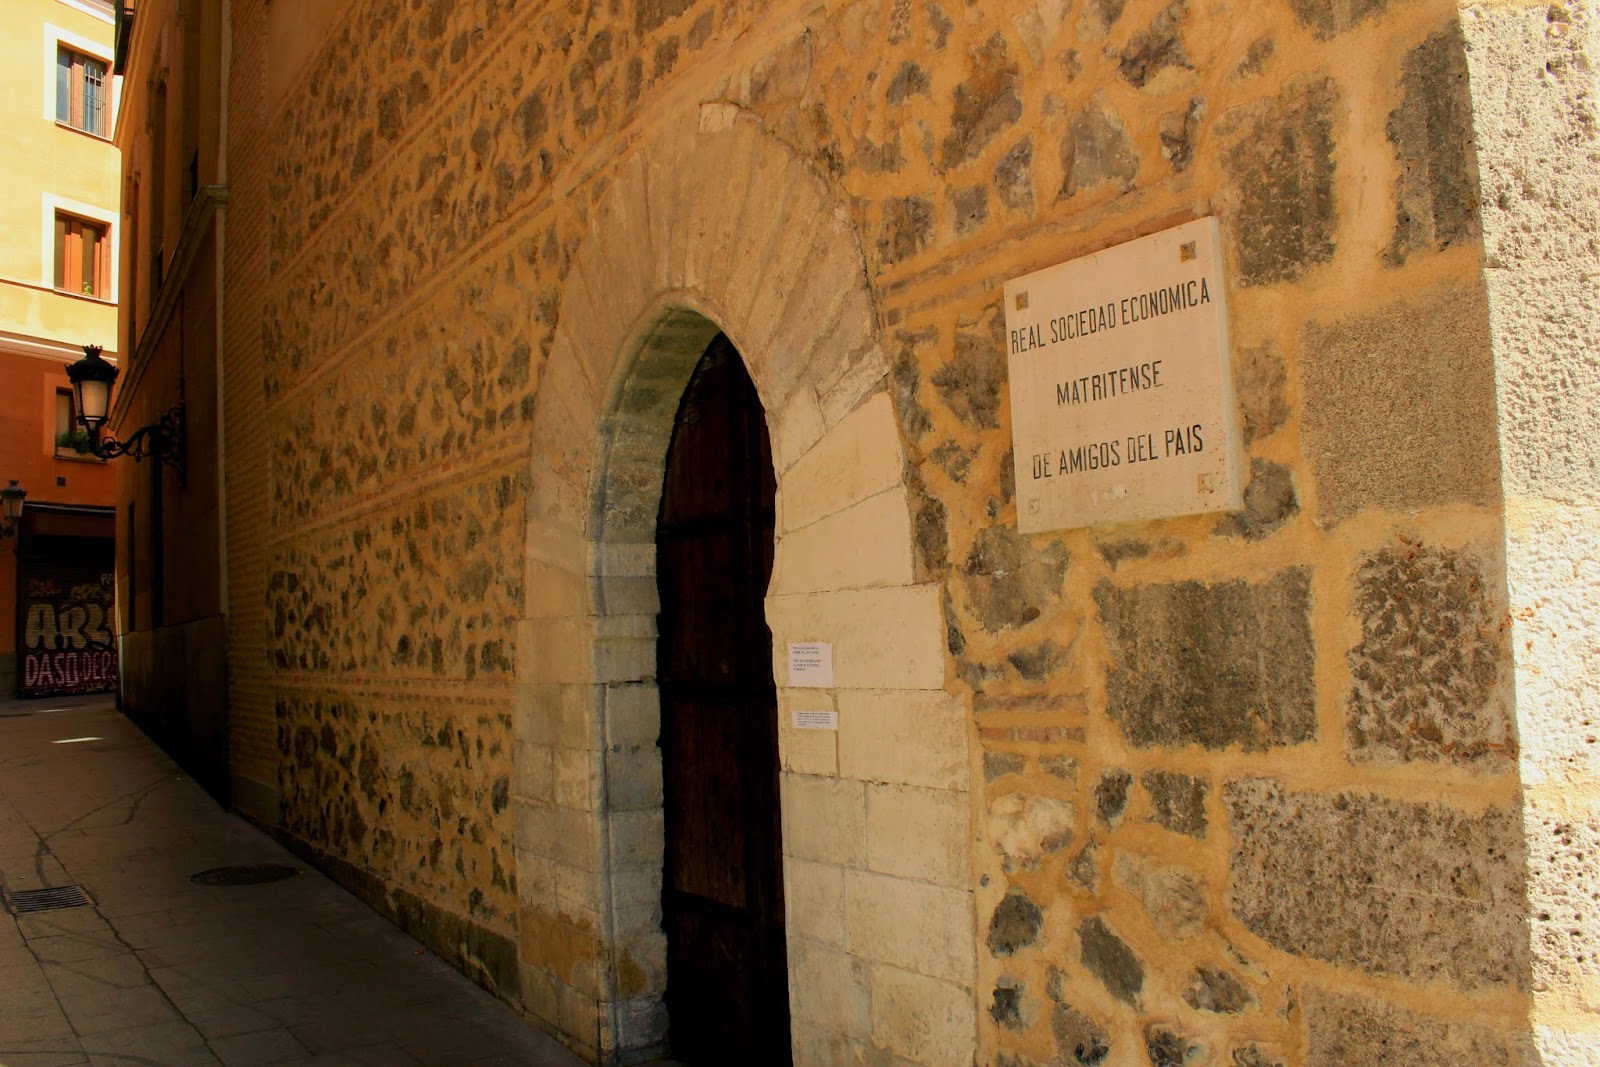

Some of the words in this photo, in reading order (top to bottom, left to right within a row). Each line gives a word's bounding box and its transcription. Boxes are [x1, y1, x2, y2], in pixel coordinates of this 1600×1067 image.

[1011, 324, 1046, 355] REAL
[1050, 302, 1116, 344] SOCIEDAD
[1121, 277, 1210, 326] ECONOMICA
[1056, 360, 1164, 407] MATRITENSE
[1033, 453, 1052, 480] DE
[1059, 439, 1121, 476] AMIGOS
[1127, 433, 1159, 465] DEL
[1164, 424, 1203, 458] PAIS
